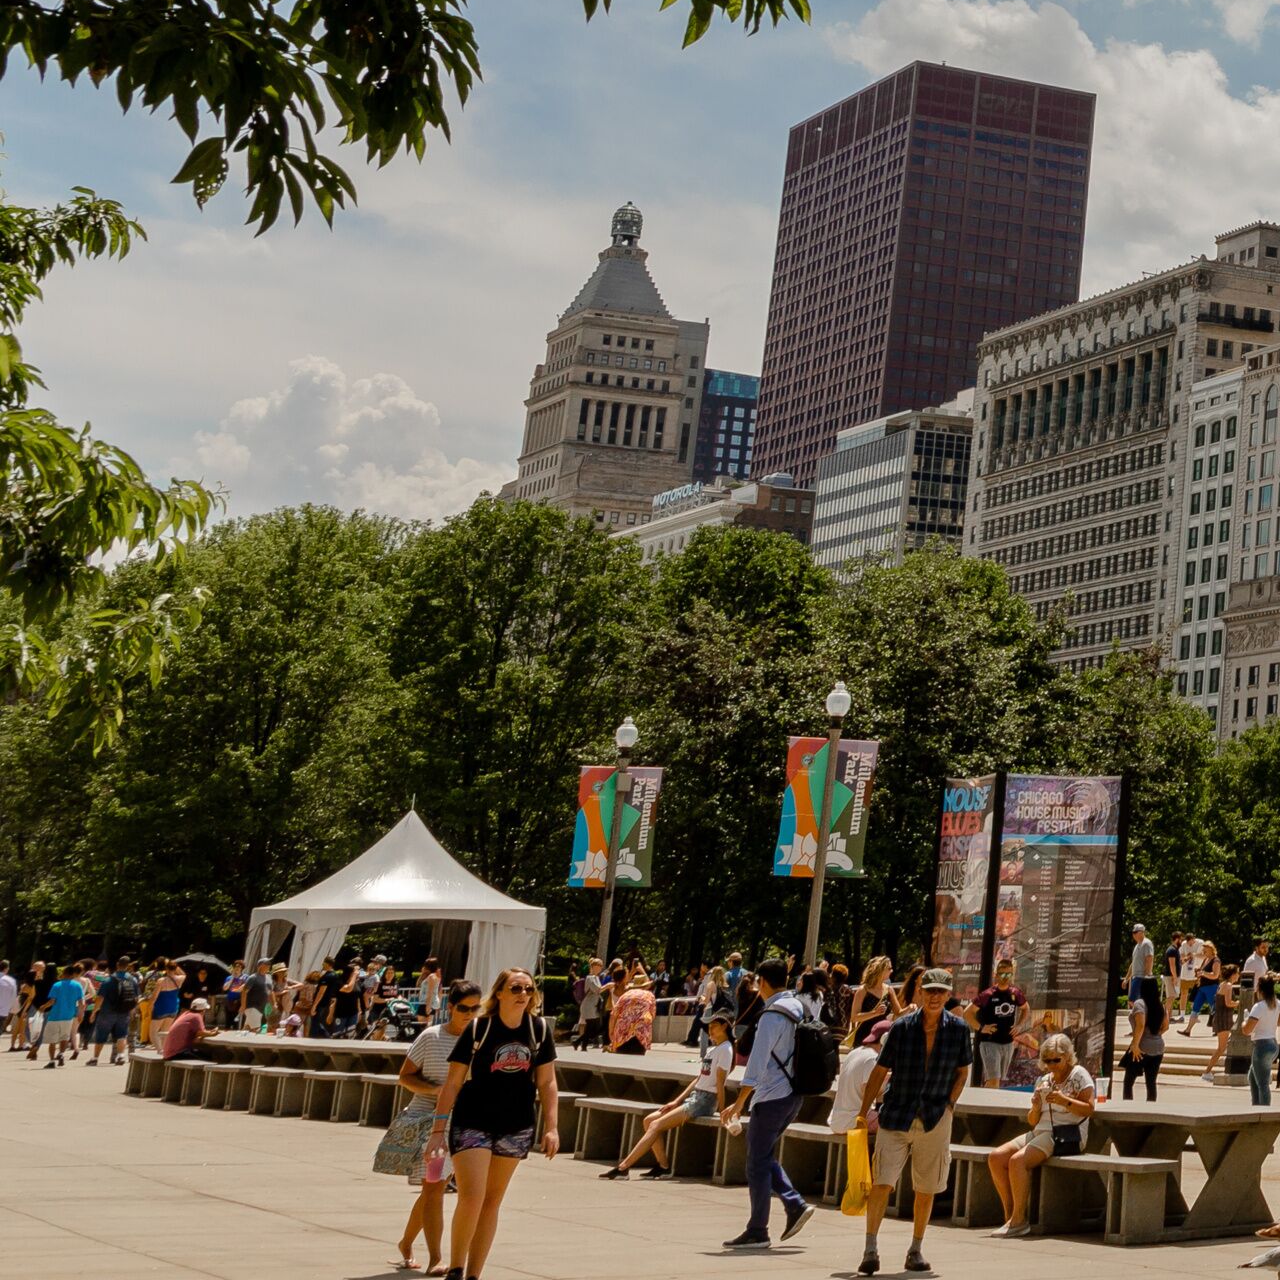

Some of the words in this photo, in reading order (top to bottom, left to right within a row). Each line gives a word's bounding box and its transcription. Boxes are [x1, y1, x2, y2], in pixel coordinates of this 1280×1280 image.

[843, 751, 860, 785] Park
[631, 777, 646, 806] Park
[849, 751, 873, 836] Millennium
[943, 784, 992, 812] HOUSE
[1017, 790, 1064, 805] CHICAGO
[638, 777, 658, 851] Millennium
[940, 811, 982, 836] BLUES
[1016, 805, 1051, 819] HOUSE
[1052, 806, 1087, 819] MUSIC
[1036, 820, 1086, 834] FESTIVAL
[936, 860, 988, 889] MUSIC
[994, 1002, 1015, 1015] EOS
